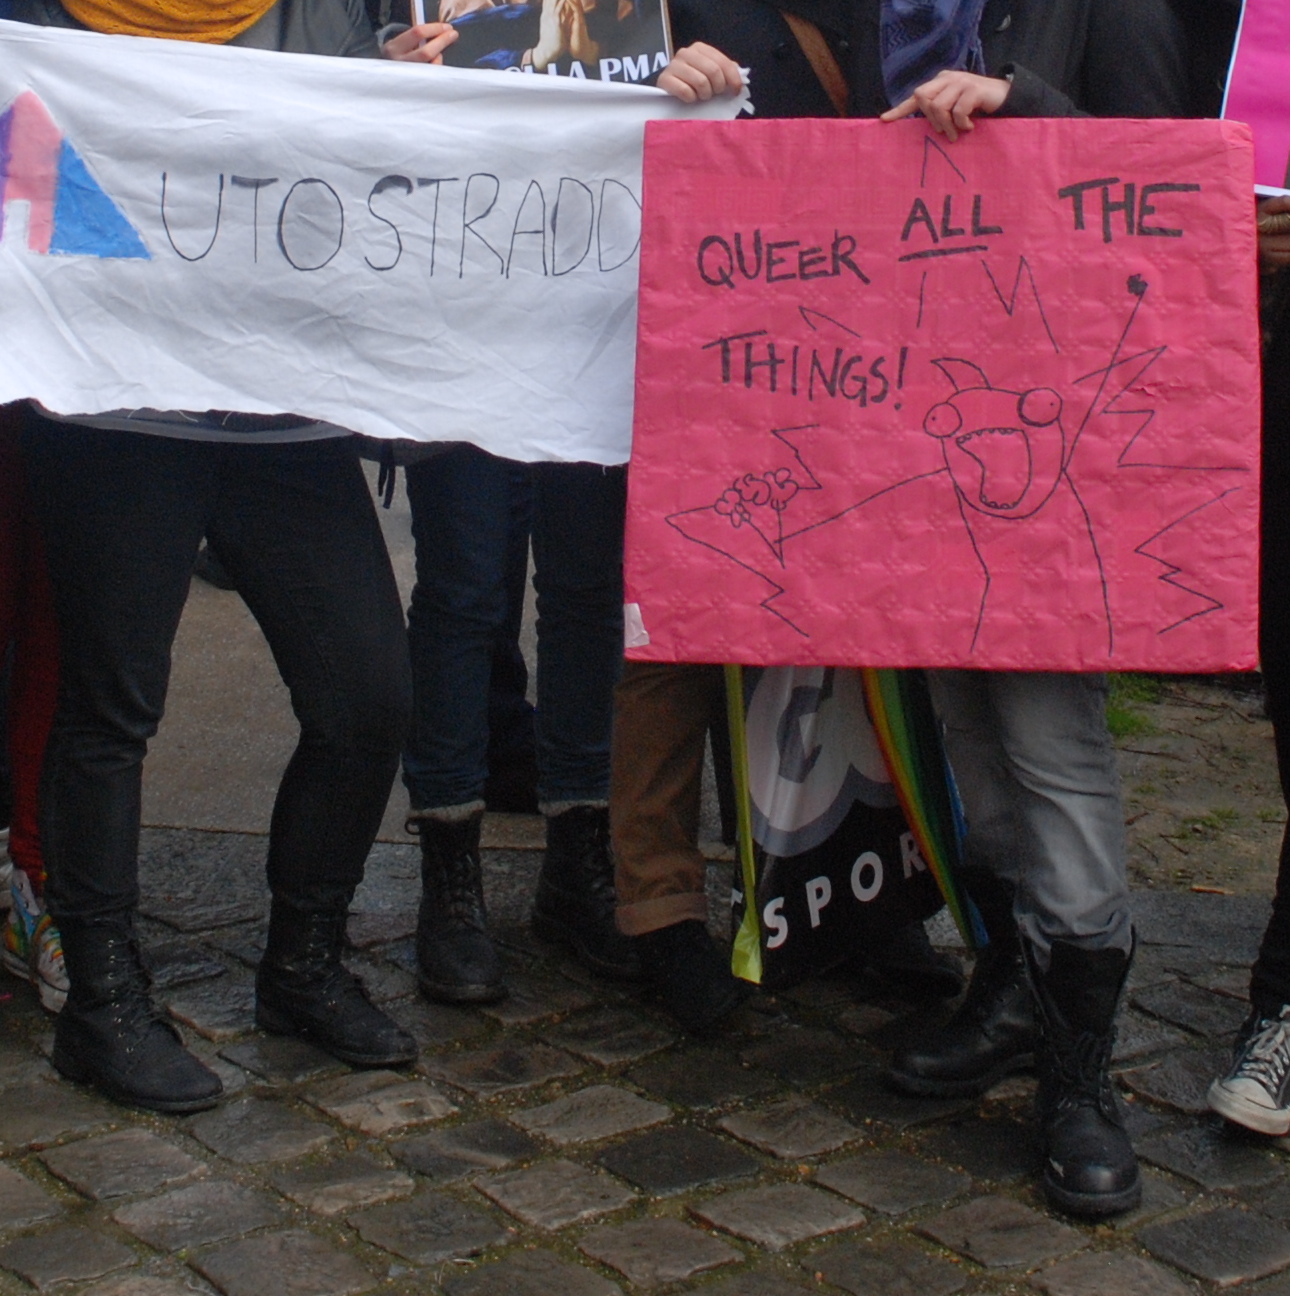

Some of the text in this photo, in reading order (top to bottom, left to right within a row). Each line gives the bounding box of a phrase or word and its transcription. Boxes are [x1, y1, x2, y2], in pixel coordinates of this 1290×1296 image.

[696, 176, 1201, 287] QUEER ALL THE
[701, 328, 909, 410] THINGS!
